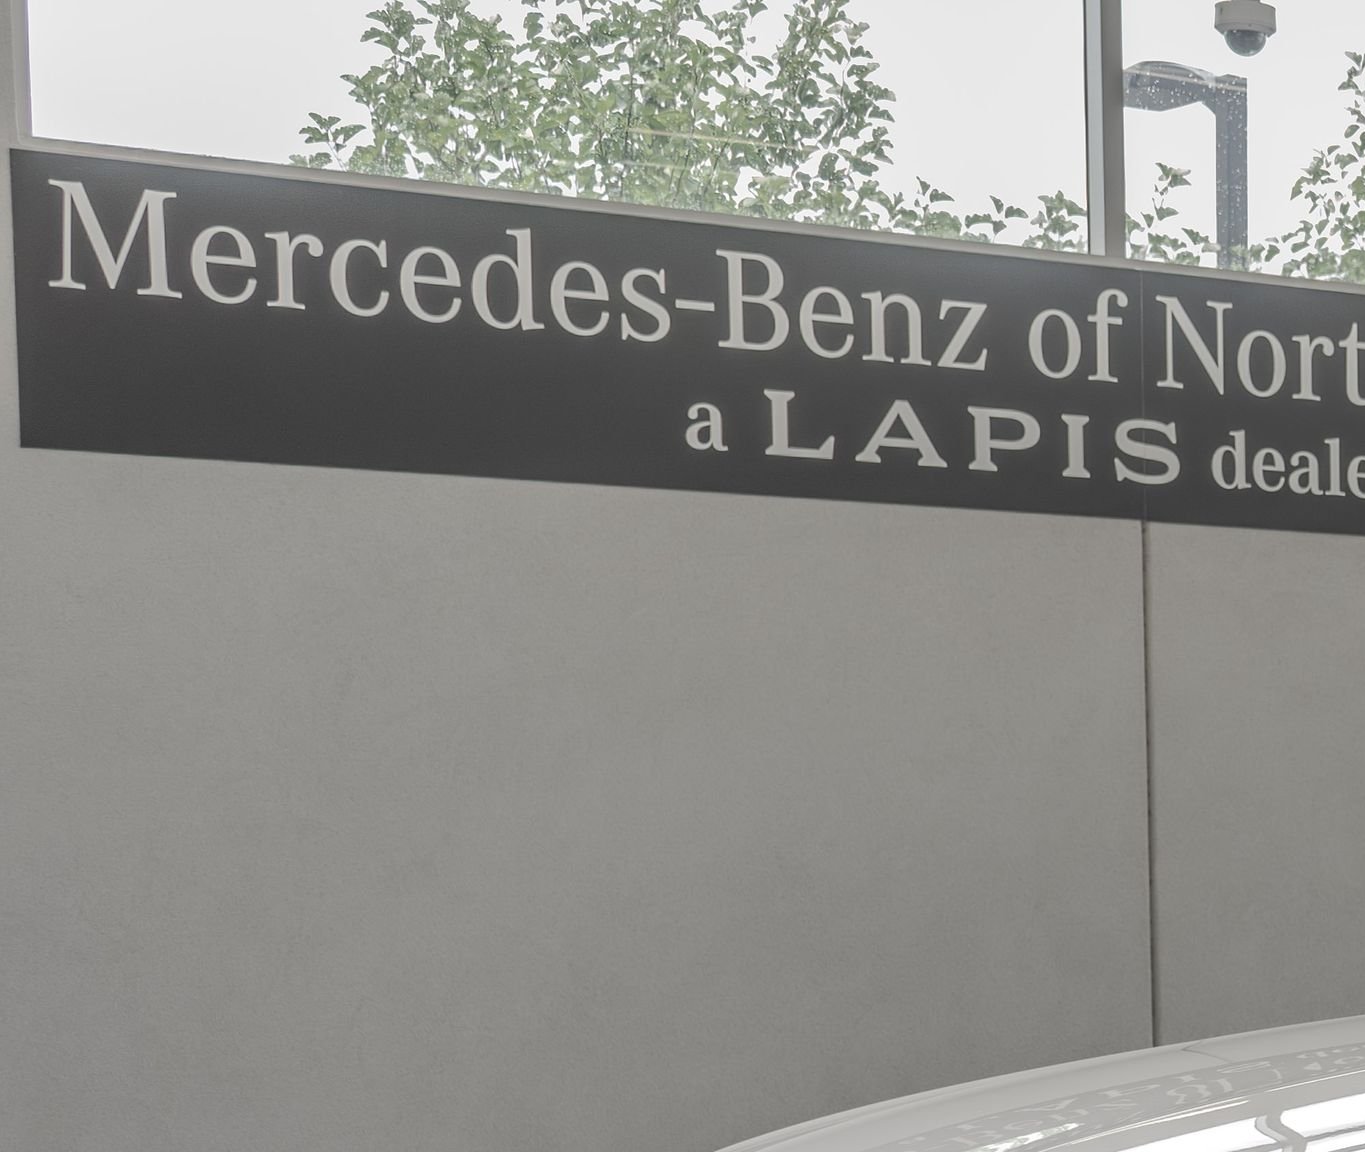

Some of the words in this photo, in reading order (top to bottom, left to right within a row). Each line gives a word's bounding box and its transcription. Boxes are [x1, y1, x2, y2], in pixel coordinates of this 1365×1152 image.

[47, 178, 988, 371] Mercedes-Benz
[1028, 288, 1129, 383] of
[685, 402, 729, 452] a
[763, 388, 1181, 485] LAPIS
